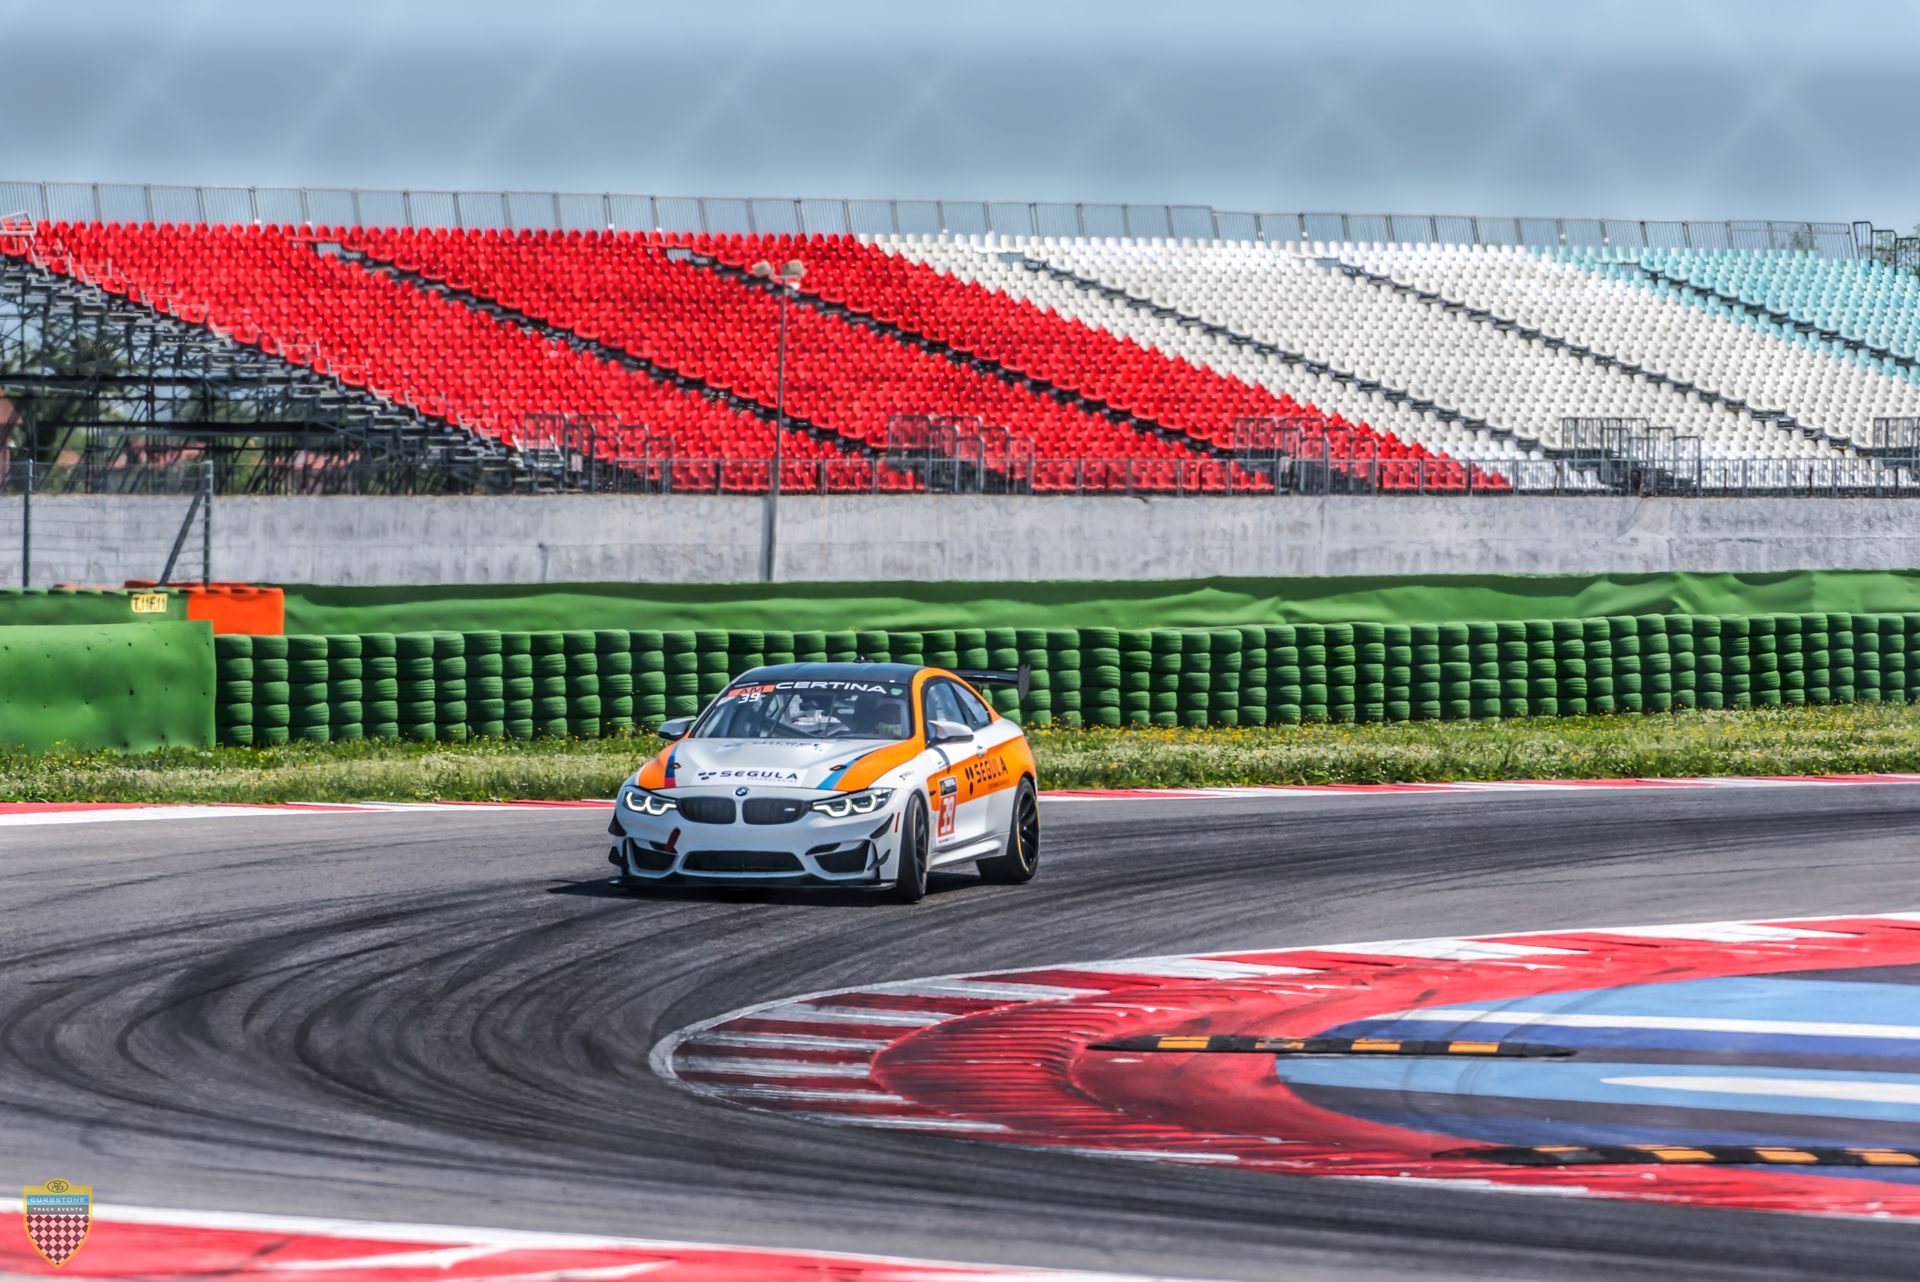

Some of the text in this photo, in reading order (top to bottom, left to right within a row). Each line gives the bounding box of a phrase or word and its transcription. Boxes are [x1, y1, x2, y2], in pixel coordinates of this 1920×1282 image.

[775, 681, 888, 695] CERTINA
[738, 693, 761, 704] 39
[719, 770, 799, 781] SEGULA
[974, 756, 1009, 784] SEGULA
